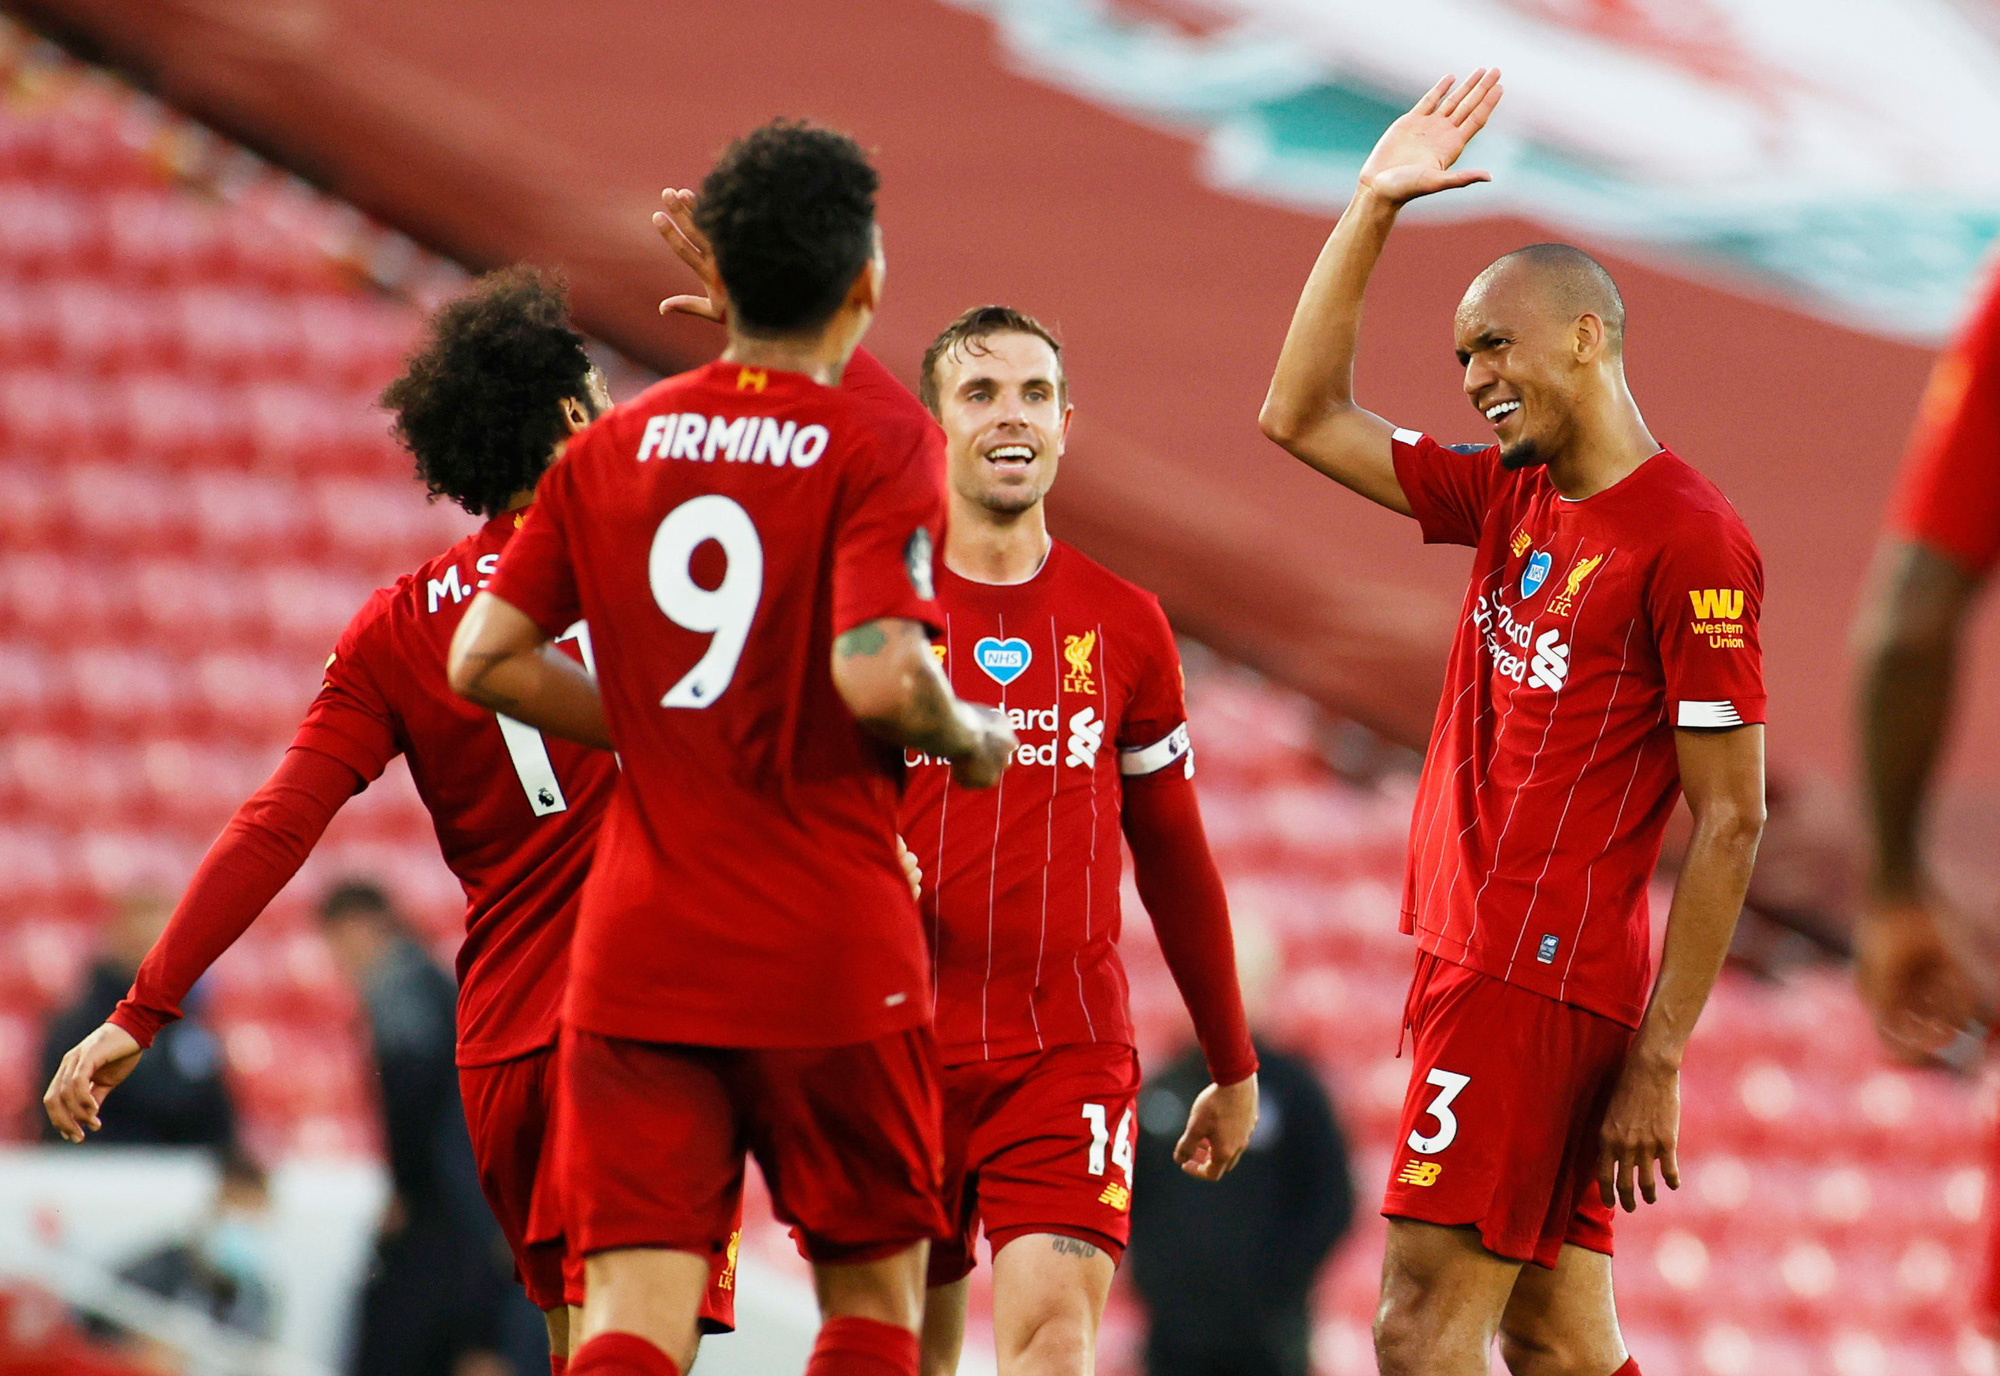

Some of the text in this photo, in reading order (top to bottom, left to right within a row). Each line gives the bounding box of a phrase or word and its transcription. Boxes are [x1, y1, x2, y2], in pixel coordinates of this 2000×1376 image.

[637, 413, 829, 468] FIRMINO
[649, 494, 763, 709] 9
[1689, 588, 1744, 619] WU
[1691, 622, 1744, 635] Western
[1709, 635, 1745, 649] Union
[987, 653, 1018, 665] NHS
[1407, 1067, 1472, 1155] 3
[1081, 1103, 1133, 1191] 14
